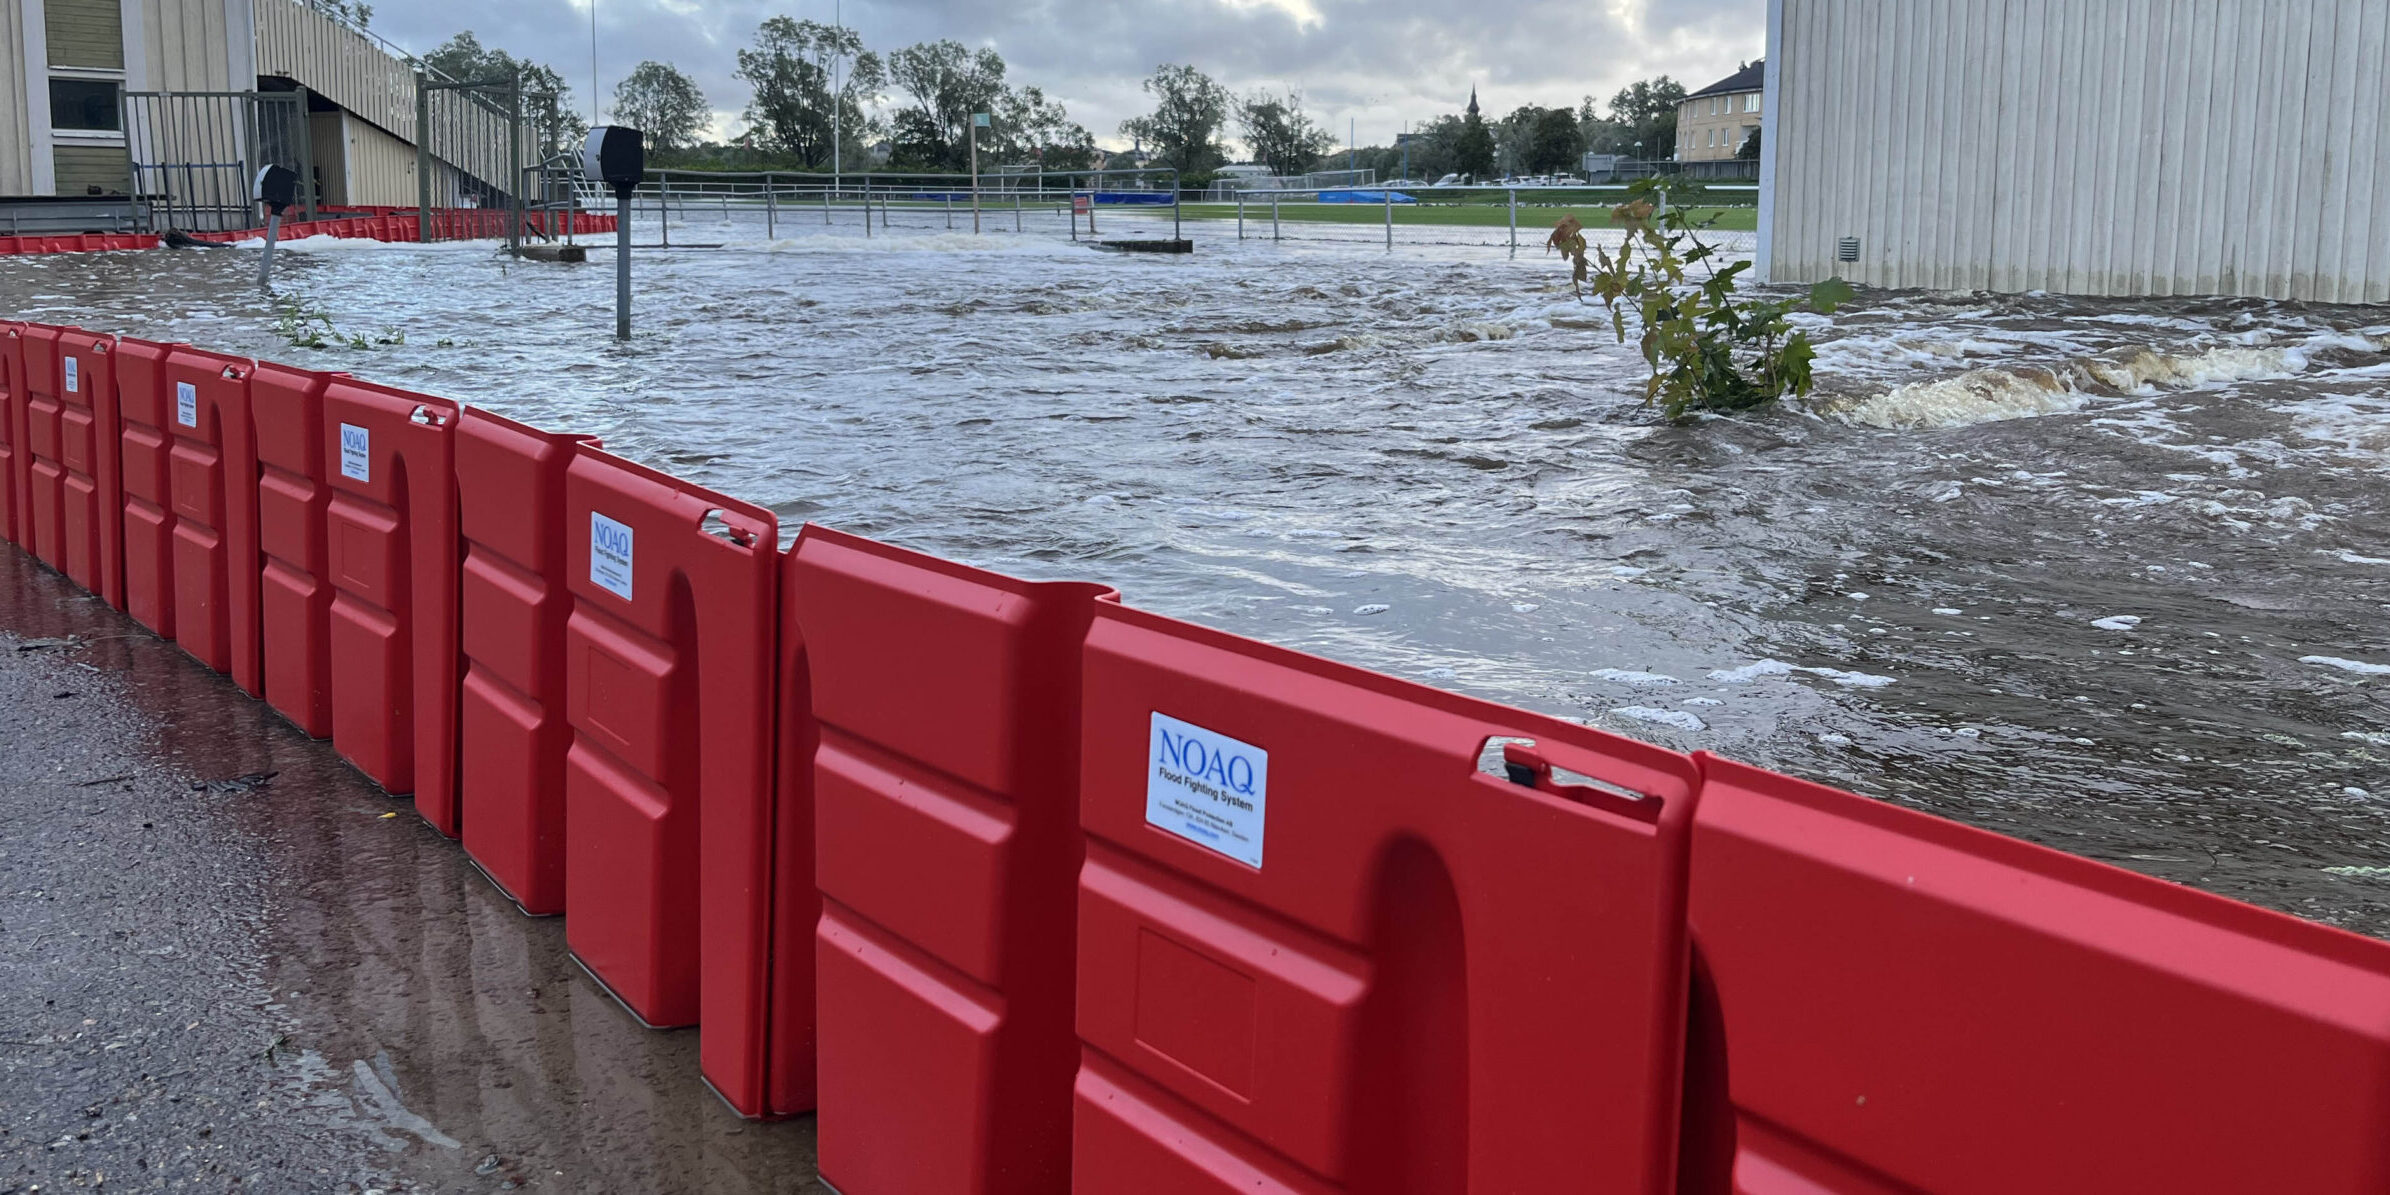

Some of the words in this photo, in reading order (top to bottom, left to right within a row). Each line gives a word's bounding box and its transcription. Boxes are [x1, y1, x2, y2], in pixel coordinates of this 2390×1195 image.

[594, 521, 629, 557] NOAQ
[1159, 728, 1256, 796] NOAQ
[1159, 767, 1182, 786] Flood
[1184, 775, 1219, 801] Fighting
[1221, 790, 1254, 812] System
